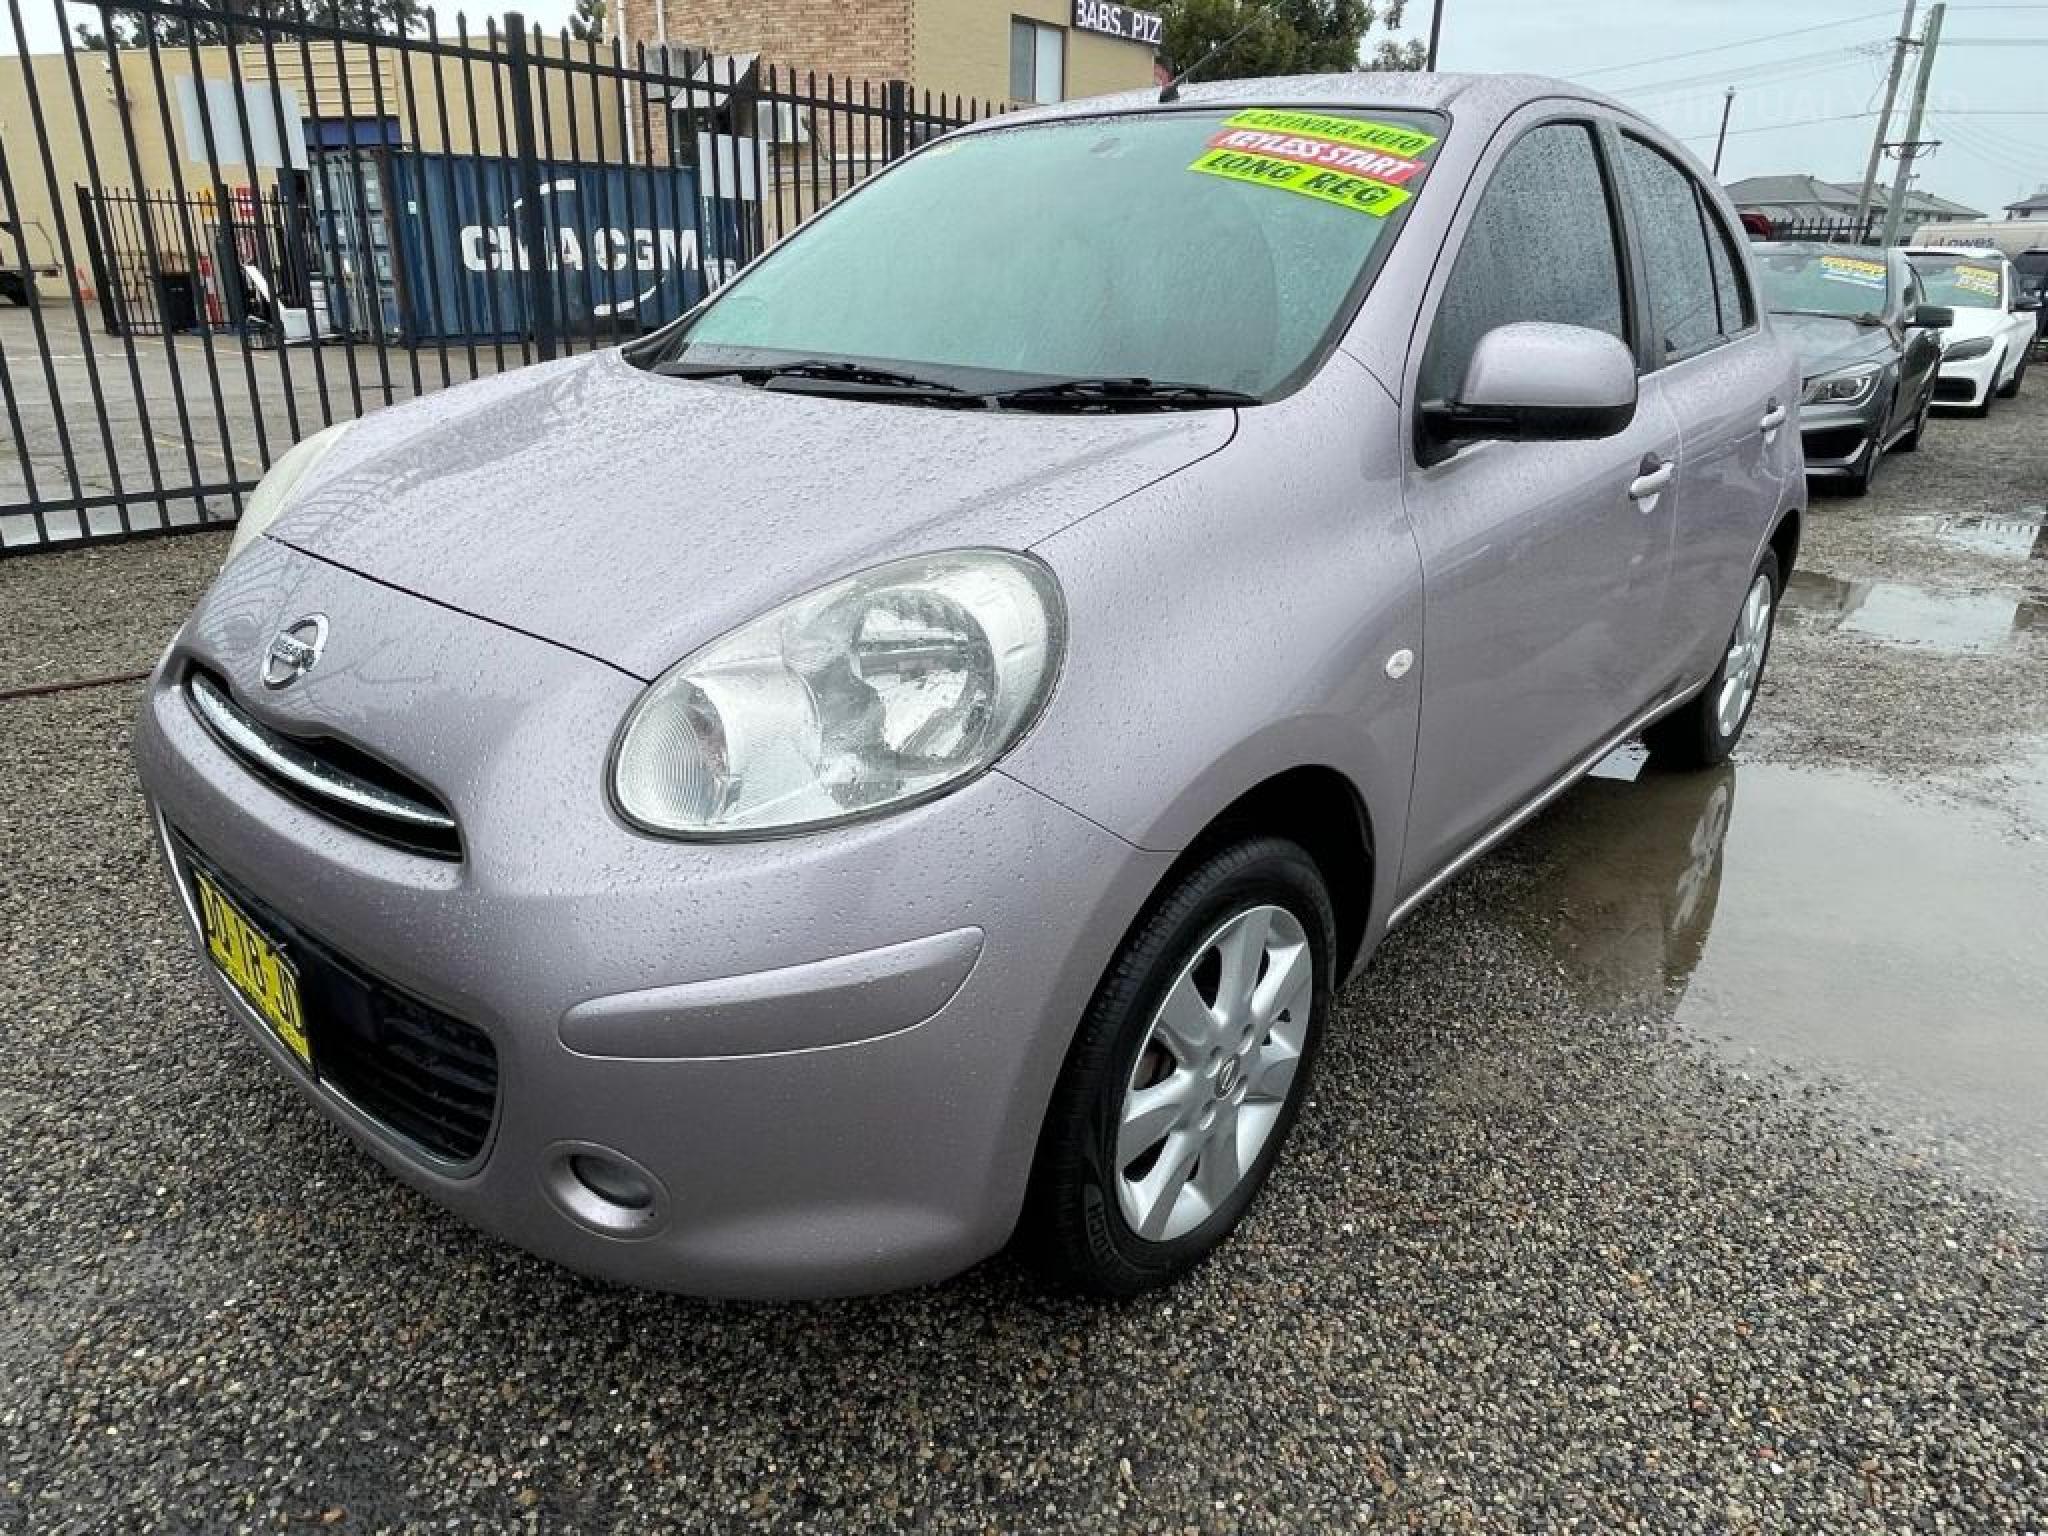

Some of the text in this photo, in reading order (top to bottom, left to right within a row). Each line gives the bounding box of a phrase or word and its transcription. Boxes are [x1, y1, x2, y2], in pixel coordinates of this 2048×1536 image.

[1217, 129, 1416, 177] KEYLESS START
[1206, 152, 1392, 205] LONG REG
[593, 226, 699, 271] CGM
